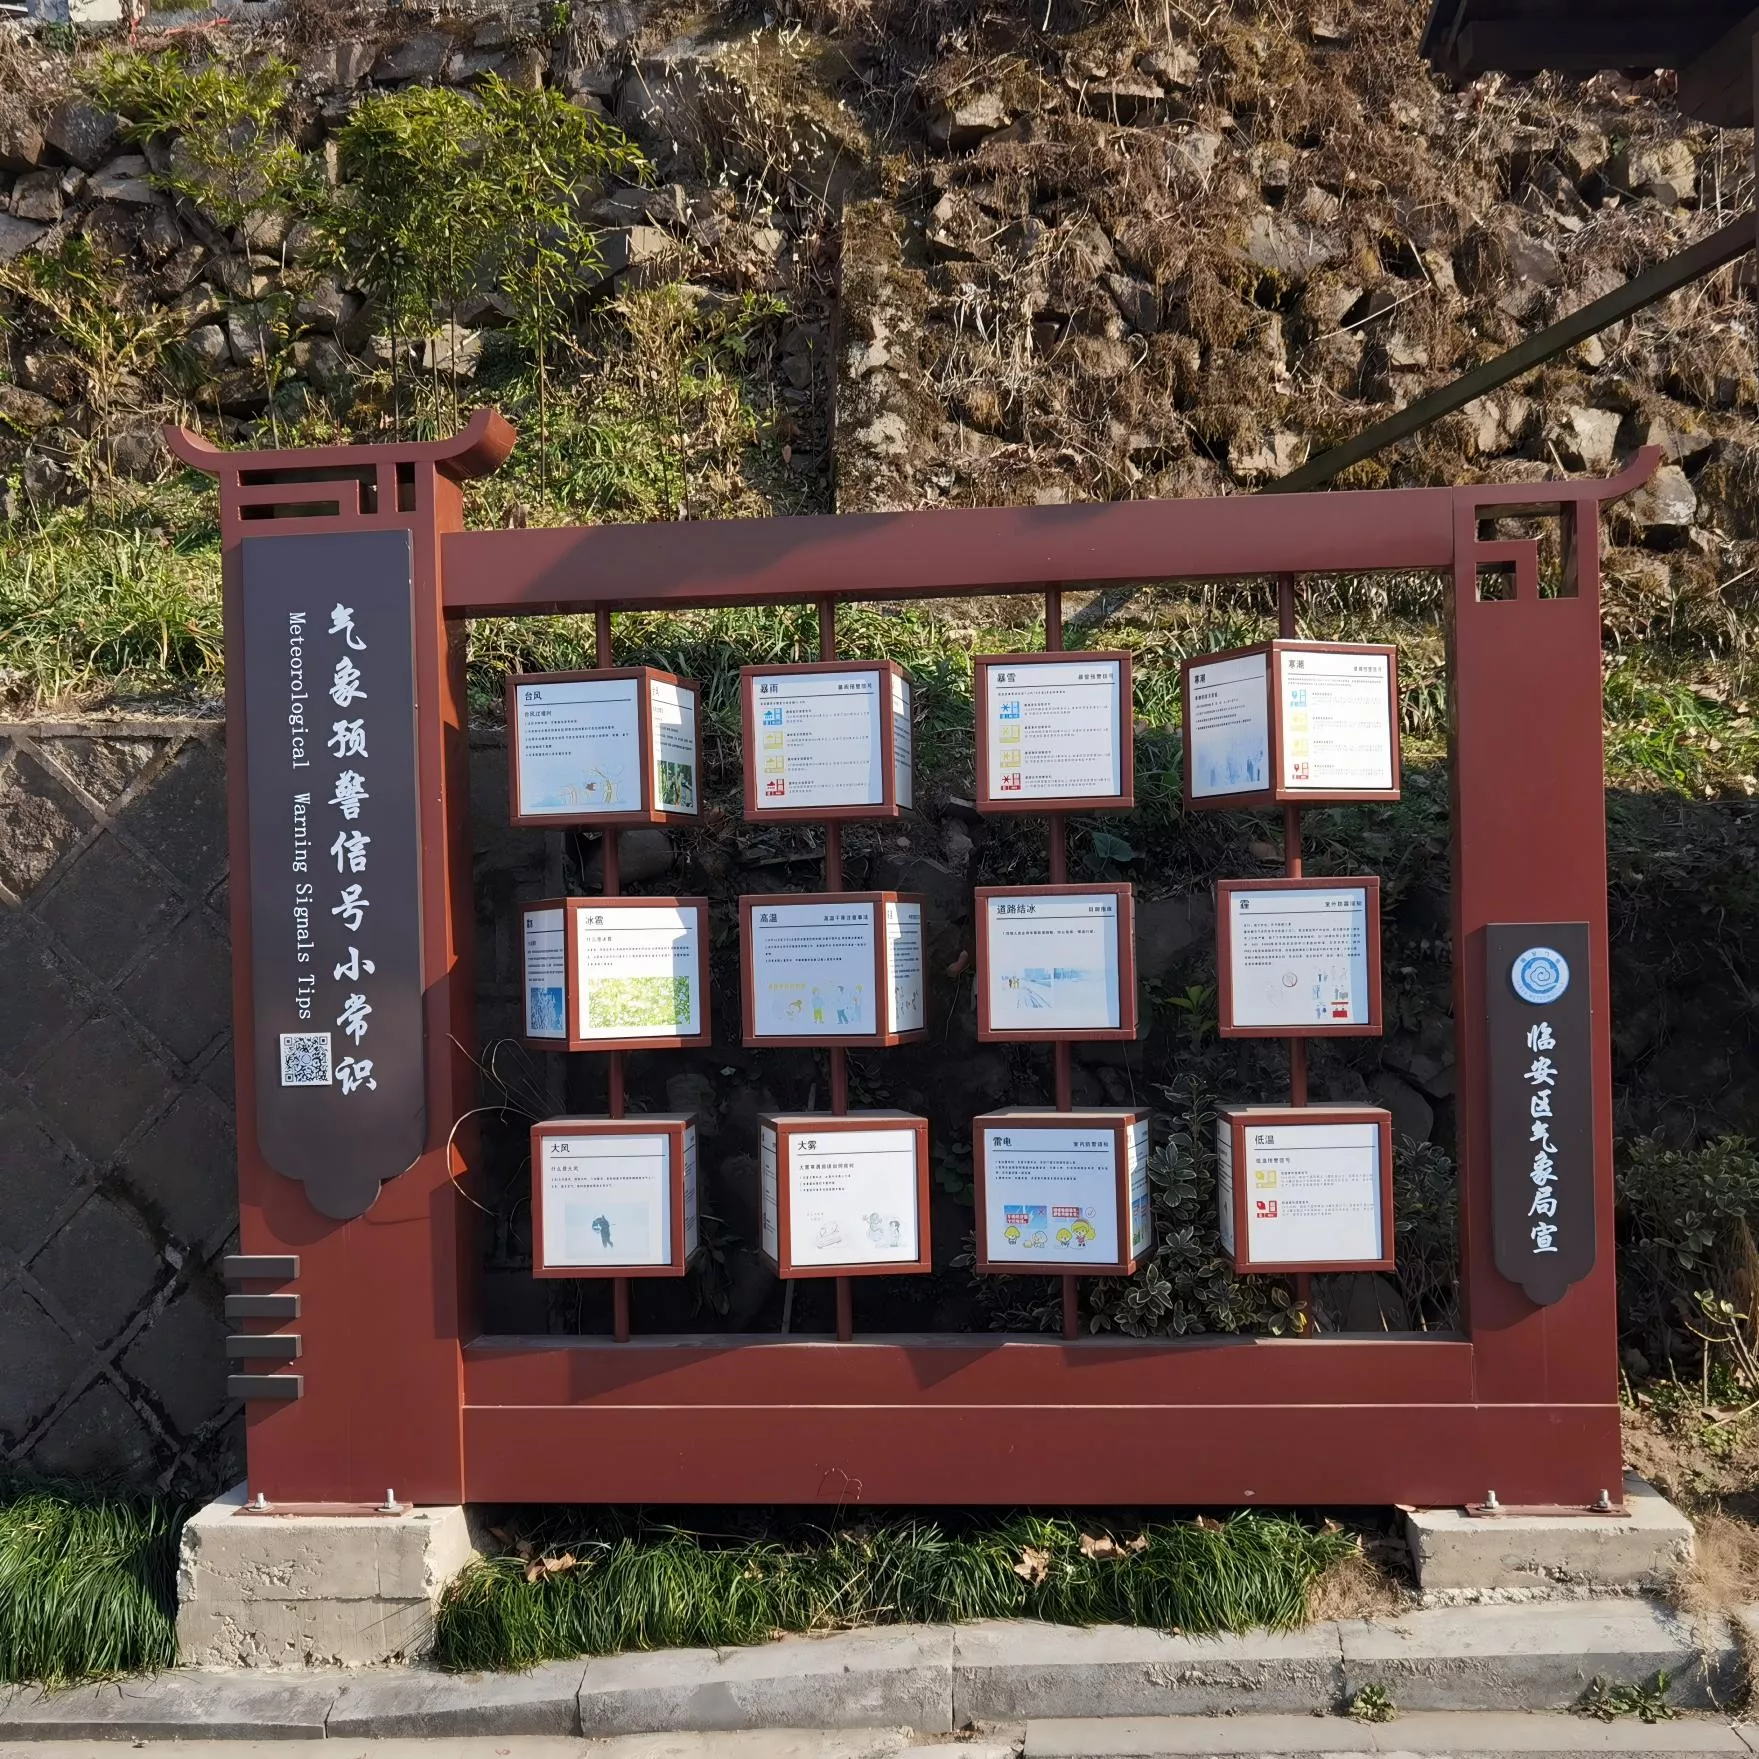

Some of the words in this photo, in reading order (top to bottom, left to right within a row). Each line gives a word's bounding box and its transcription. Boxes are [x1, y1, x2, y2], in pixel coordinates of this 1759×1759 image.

[1288, 660, 1305, 670] 寒潮
[997, 673, 1016, 683] 暴雪
[288, 612, 310, 770] Meteorological
[760, 683, 778, 694] 暴雨
[524, 691, 542, 701] 台风
[292, 792, 312, 873] Warning
[327, 602, 377, 1096] 气象预警信号小常识
[996, 904, 1036, 914] 道路结冰
[1239, 899, 1250, 910] 霾
[293, 883, 314, 963] Signals
[585, 915, 604, 925] 冰雹
[759, 913, 778, 923] 高温
[295, 974, 315, 1020] Tips
[992, 1137, 1012, 1147] 雷电
[1254, 1135, 1275, 1145] 低温
[1523, 1021, 1559, 1253] 临安区气象局宣
[551, 1143, 570, 1153] 大风
[797, 1140, 817, 1151] 大雾
